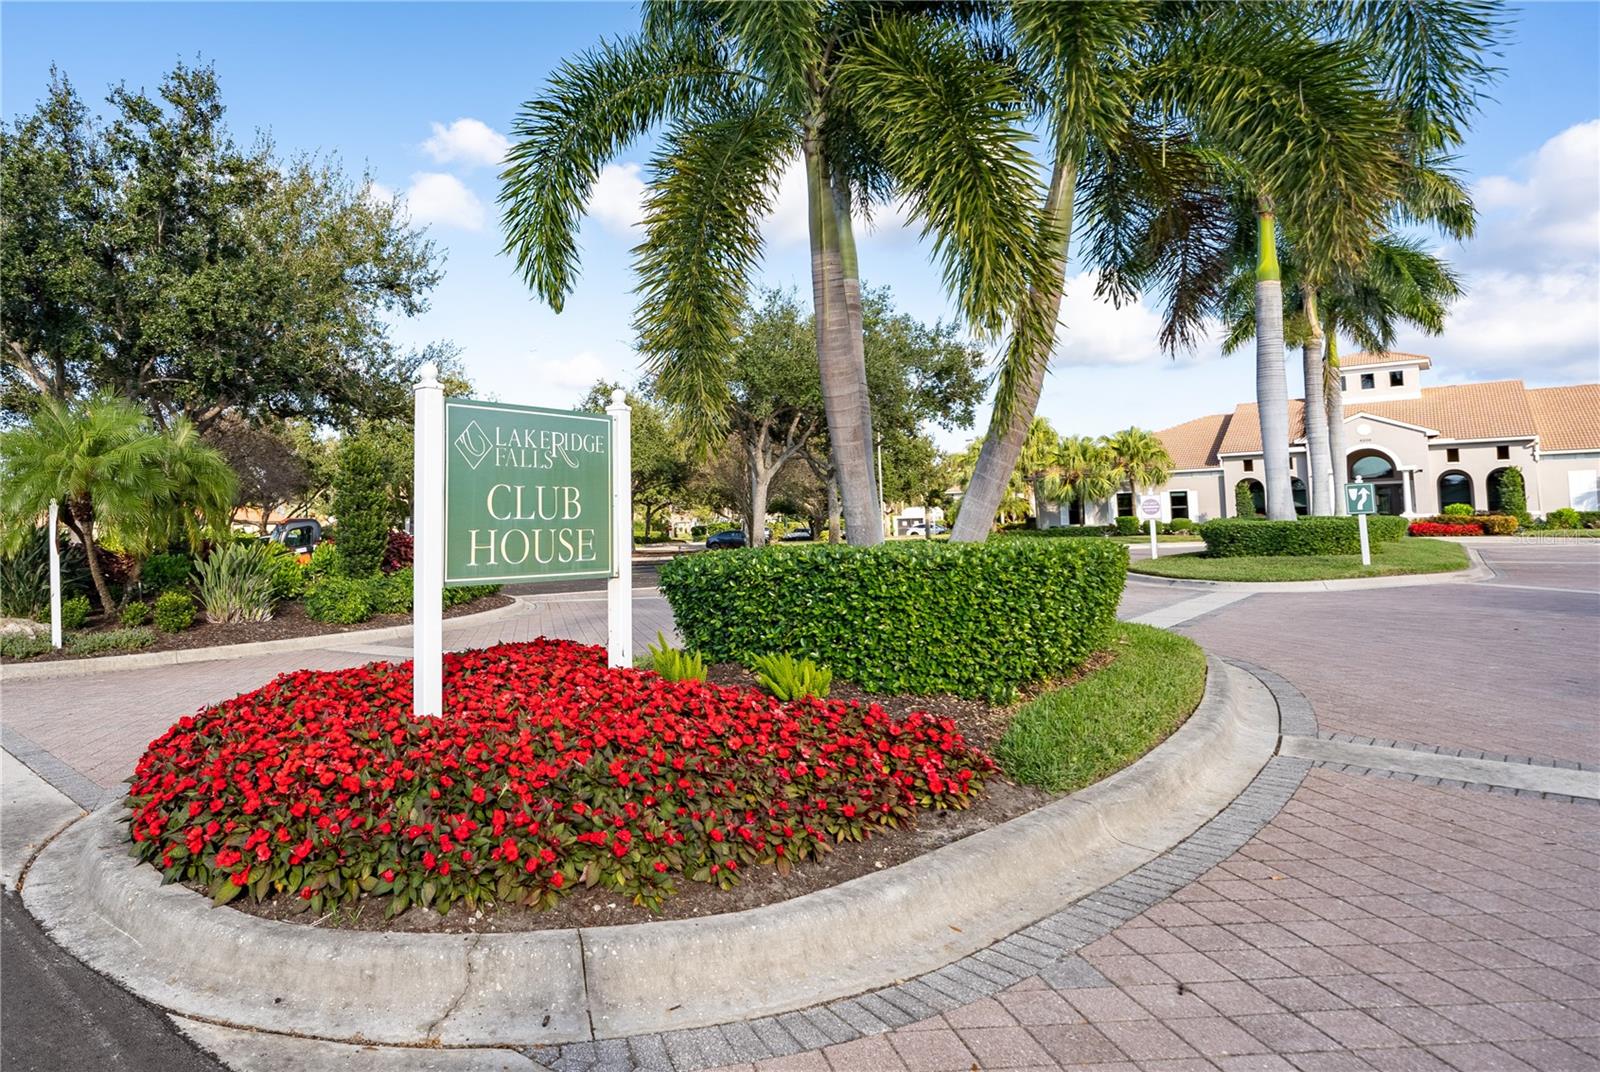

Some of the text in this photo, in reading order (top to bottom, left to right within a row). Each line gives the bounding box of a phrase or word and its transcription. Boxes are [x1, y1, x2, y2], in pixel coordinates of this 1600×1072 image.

[495, 426, 605, 469] LAKERIDGE
[495, 447, 554, 470] FALLS
[486, 483, 582, 521] CLUB
[466, 527, 597, 567] HOUSE
